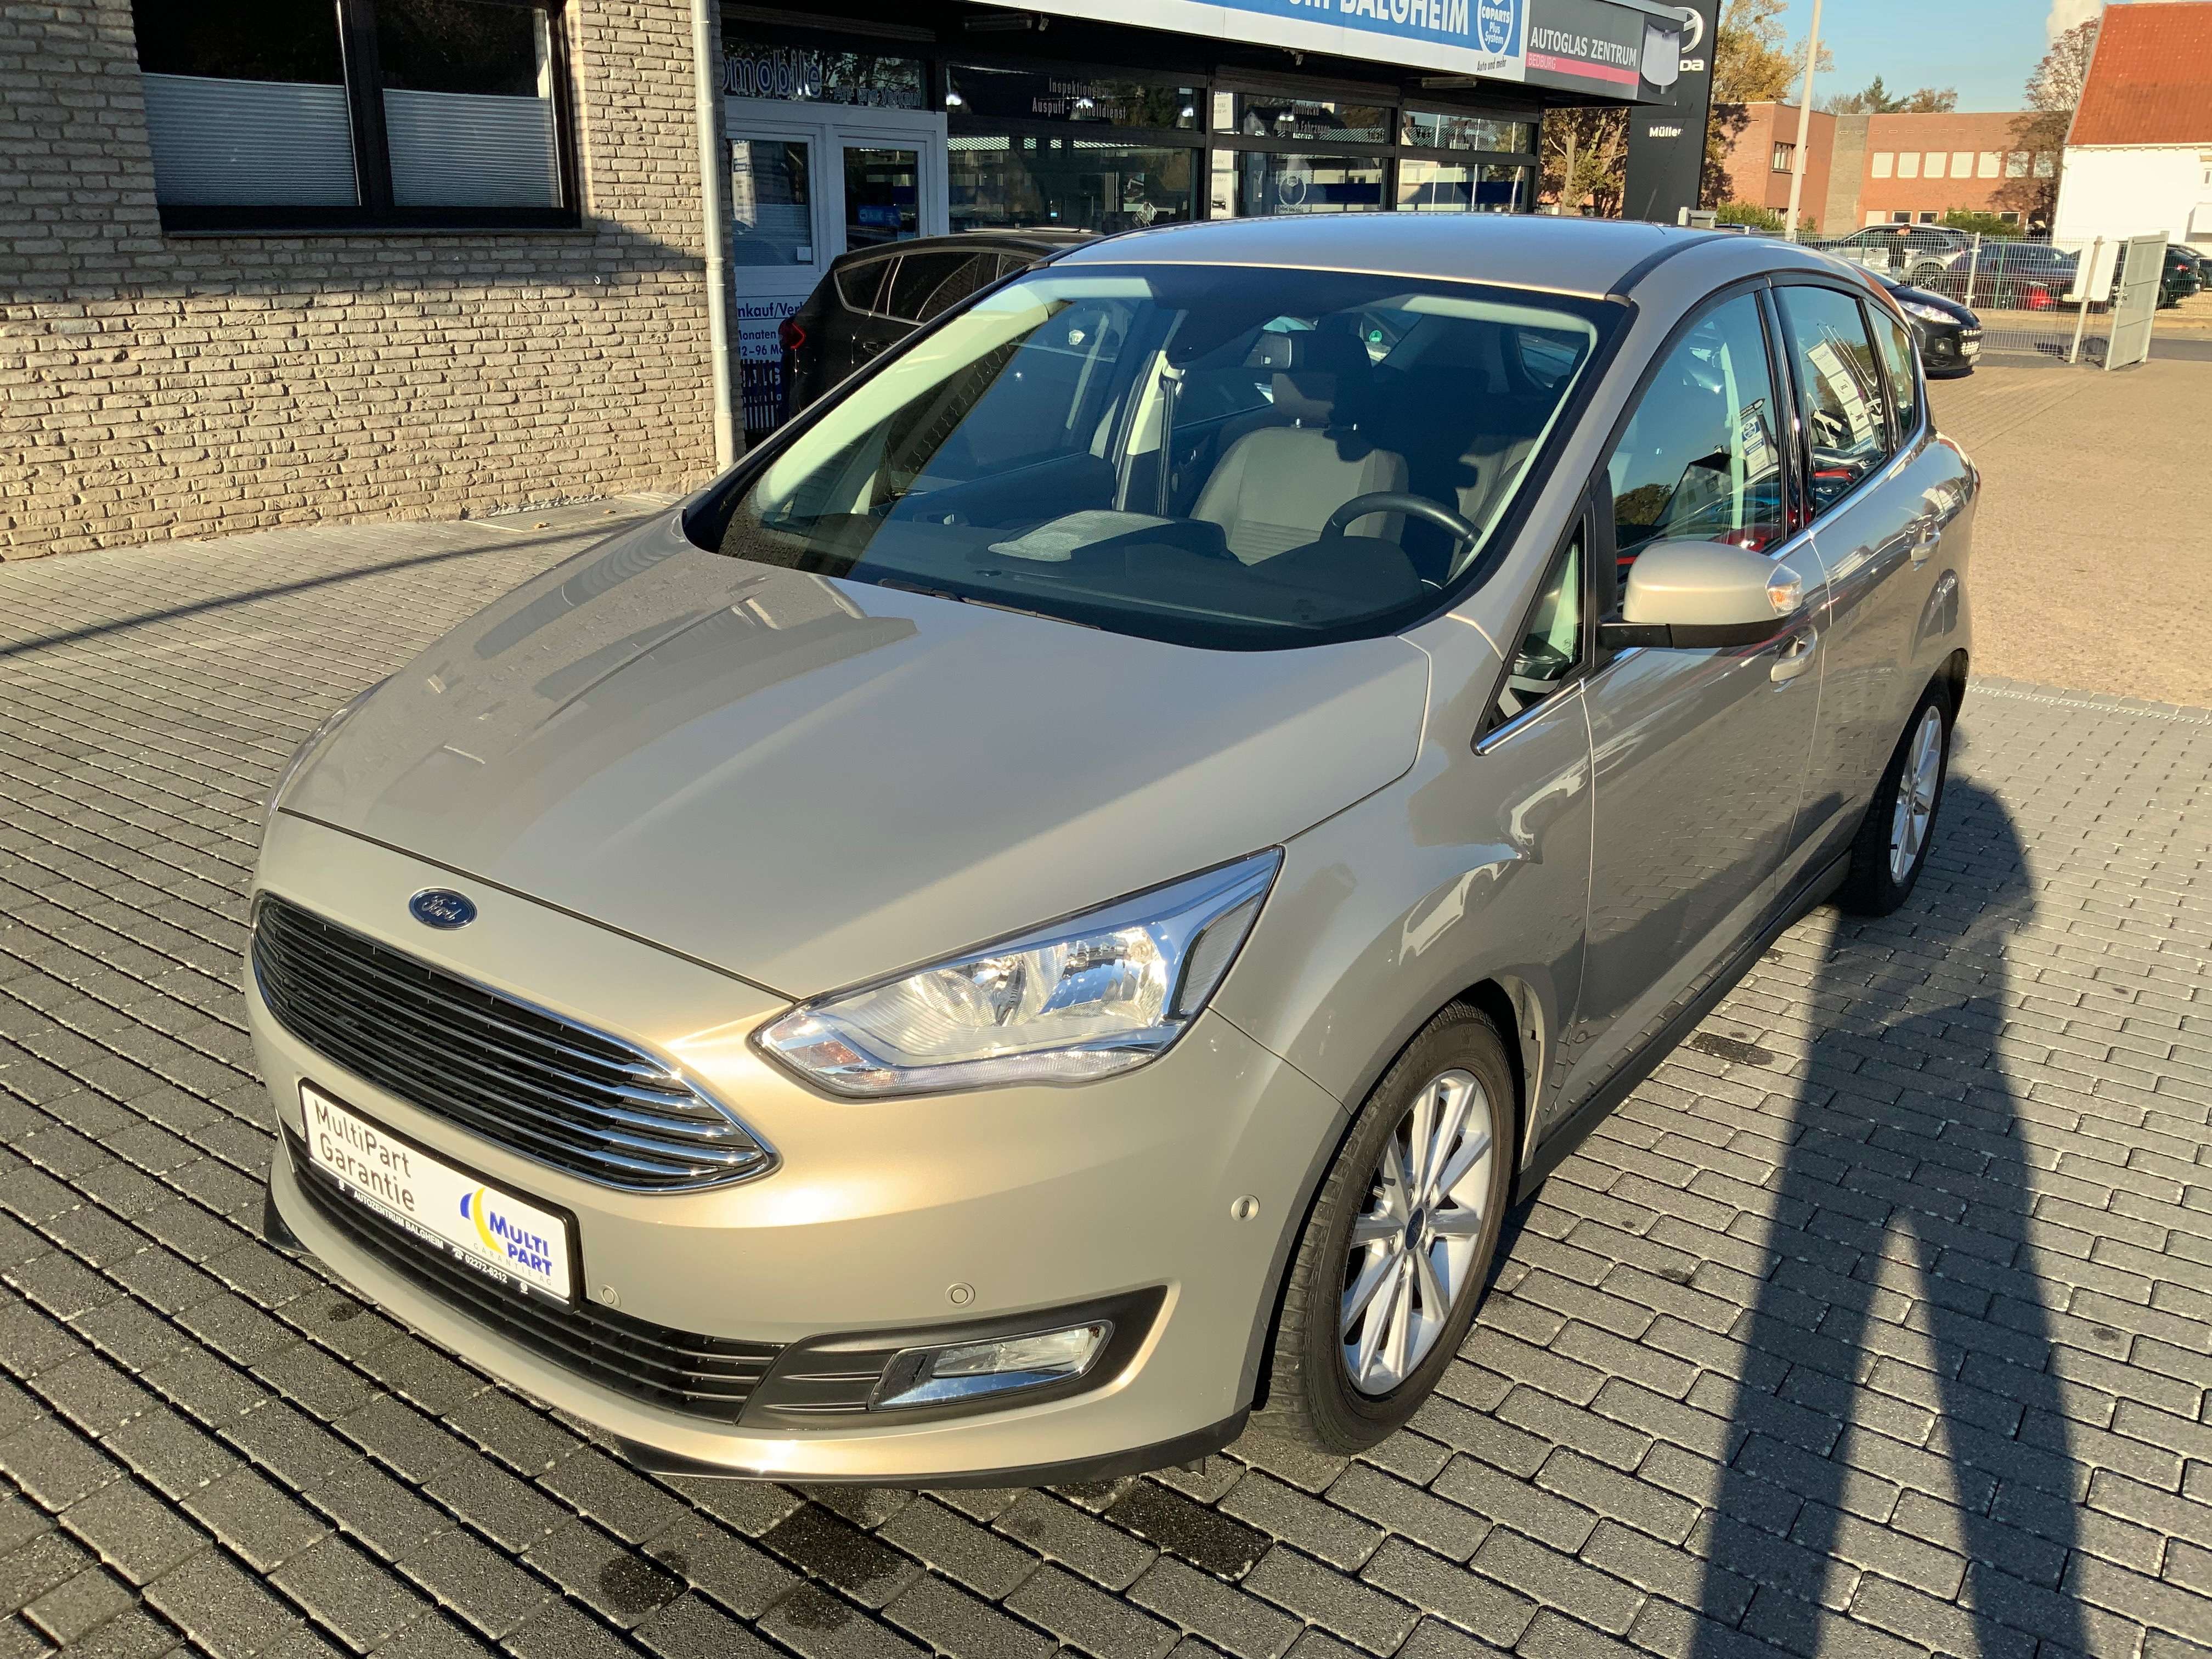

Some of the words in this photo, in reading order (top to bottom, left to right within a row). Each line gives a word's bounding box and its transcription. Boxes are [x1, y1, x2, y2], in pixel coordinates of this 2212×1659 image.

[1482, 6, 1510, 24] COPARTS
[1489, 22, 1500, 33] Plus
[1485, 31, 1503, 44] System
[1530, 26, 1588, 57] AUTOGLAS
[1591, 39, 1637, 67] ZENTRUM
[1477, 60, 1486, 72] Auto
[1496, 57, 1506, 69] mehr
[1528, 54, 1556, 70] BEDBURG
[421, 895, 462, 921] Ford
[314, 1099, 411, 1178] MultiPart
[320, 1132, 415, 1212] Garantie
[353, 1190, 404, 1227] AUTOZENTRUM
[405, 1222, 444, 1249] BALGHEIM
[489, 1211, 549, 1257] MULTI
[465, 1255, 507, 1283] 02272-6212
[473, 1243, 532, 1277] GARANTIE
[539, 1275, 552, 1286] AG
[507, 1242, 552, 1277] PART
